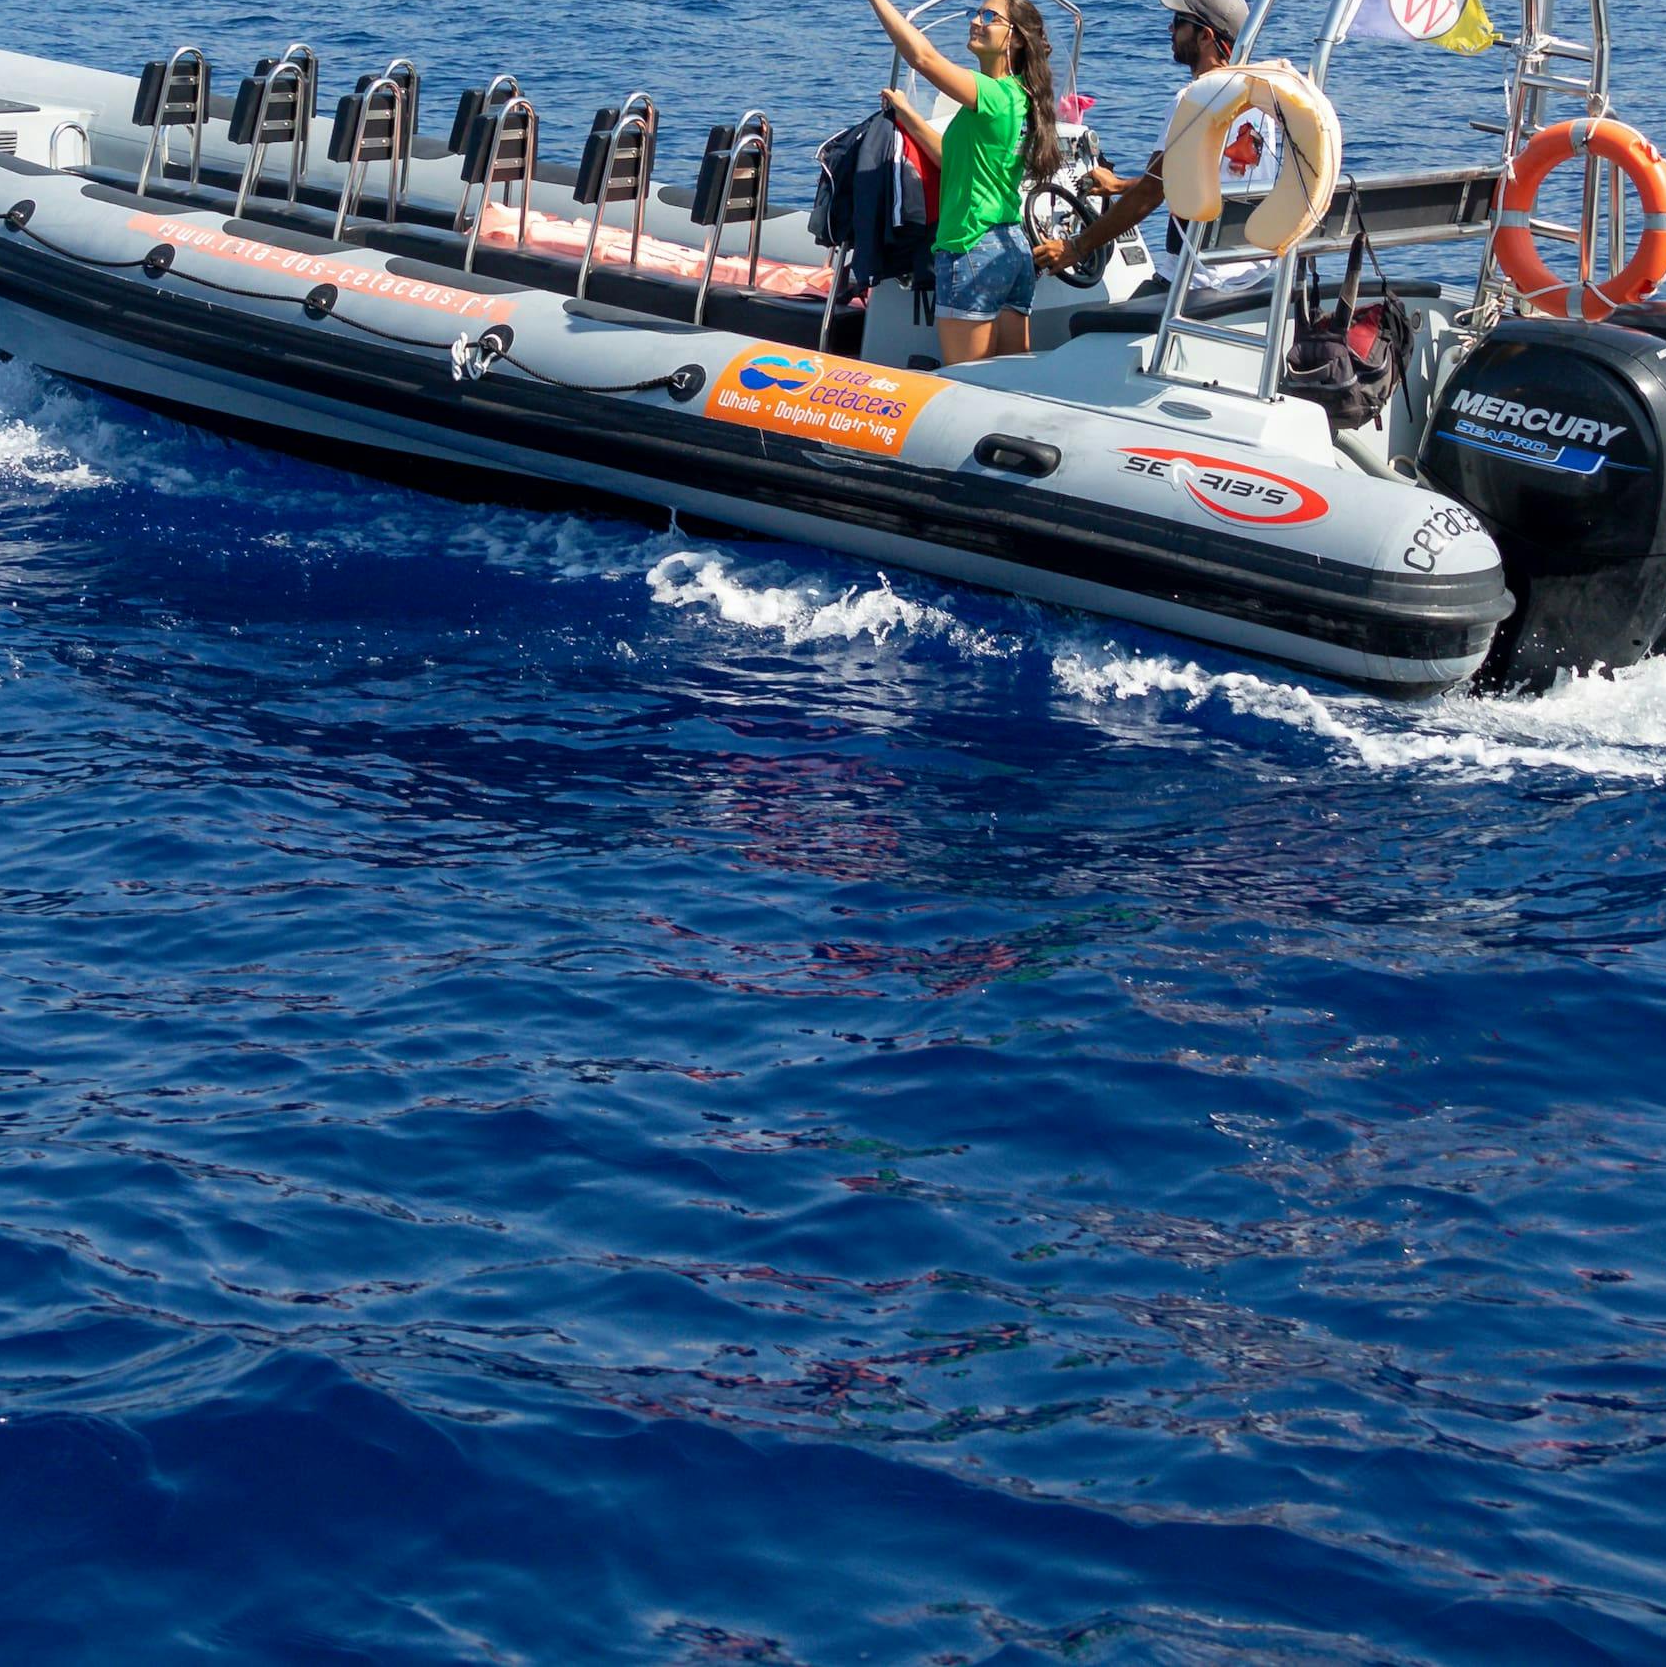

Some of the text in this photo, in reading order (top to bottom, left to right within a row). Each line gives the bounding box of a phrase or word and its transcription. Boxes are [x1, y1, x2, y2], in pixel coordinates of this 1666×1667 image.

[826, 369, 900, 393] rota dos
[718, 389, 761, 413] Whale
[774, 400, 826, 426] Dolphin
[1451, 389, 1627, 447] MERCURY
